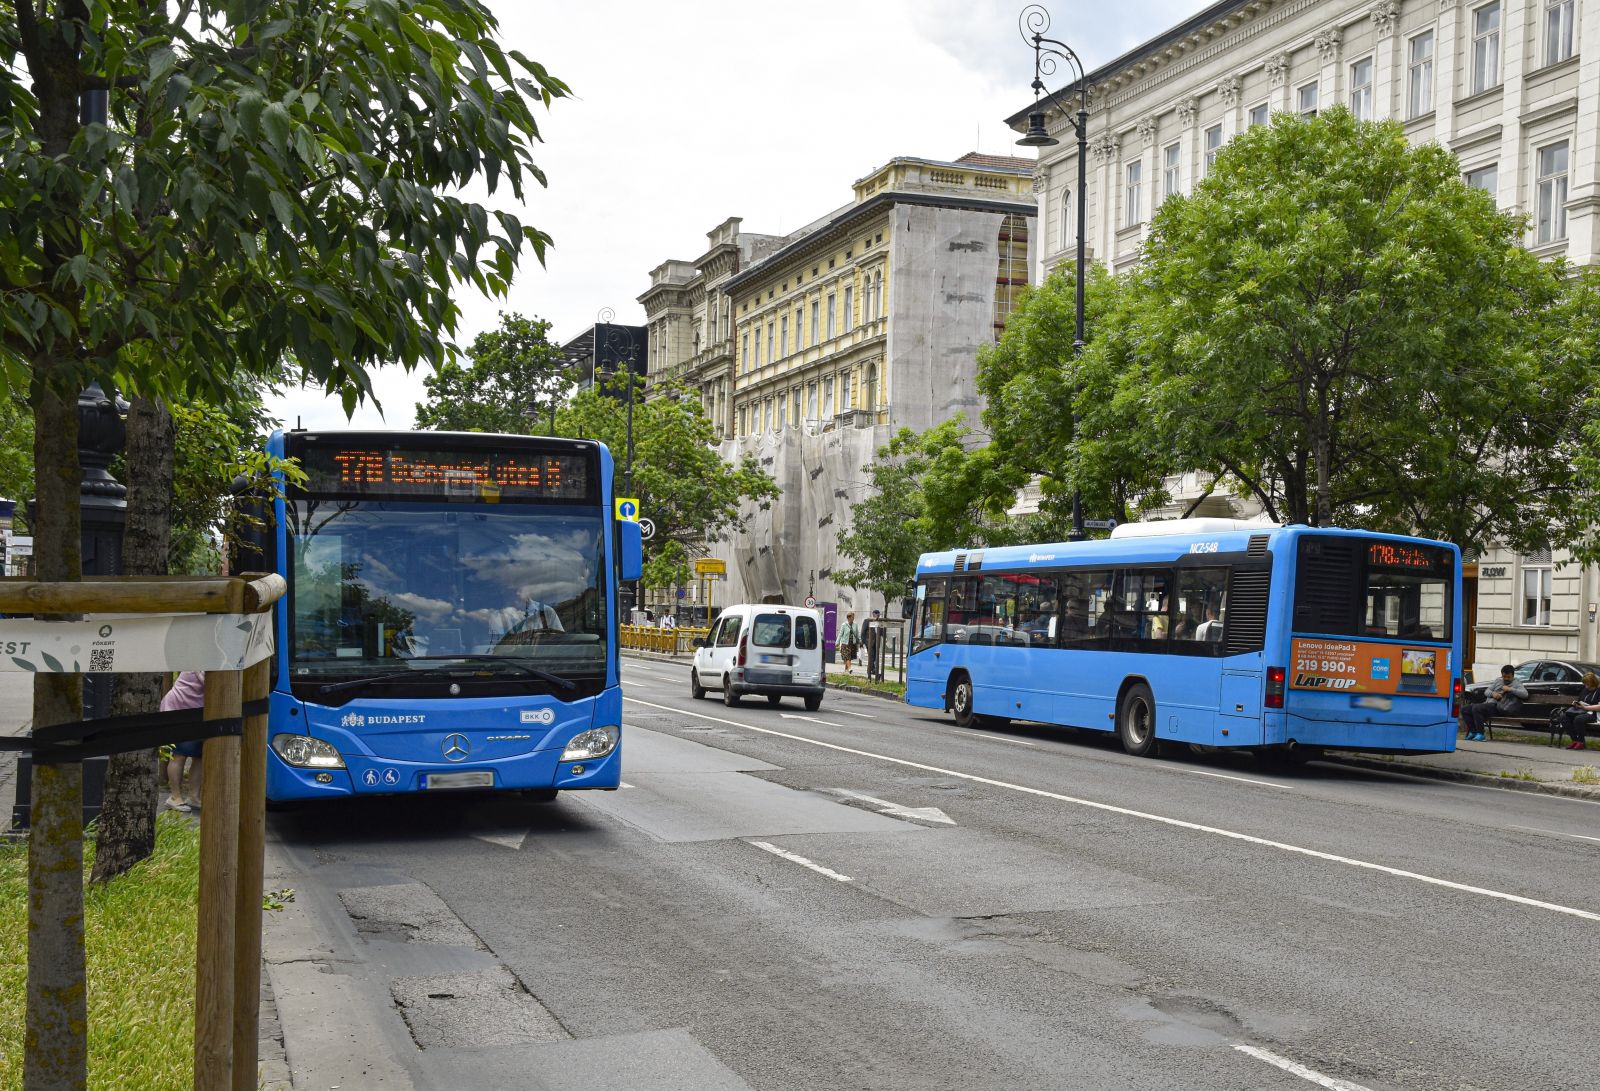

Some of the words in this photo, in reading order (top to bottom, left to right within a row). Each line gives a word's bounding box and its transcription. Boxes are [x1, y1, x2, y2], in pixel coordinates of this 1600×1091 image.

[1189, 542, 1218, 553] NCZ-548
[1298, 641, 1323, 650] Lenovo
[1324, 643, 1351, 651] IdeaPad
[1296, 659, 1318, 671] 219
[1321, 660, 1346, 673] 990
[1347, 665, 1356, 673] Ft
[1294, 673, 1356, 689] LAPTOP
[367, 714, 426, 724] BUDAPEST
